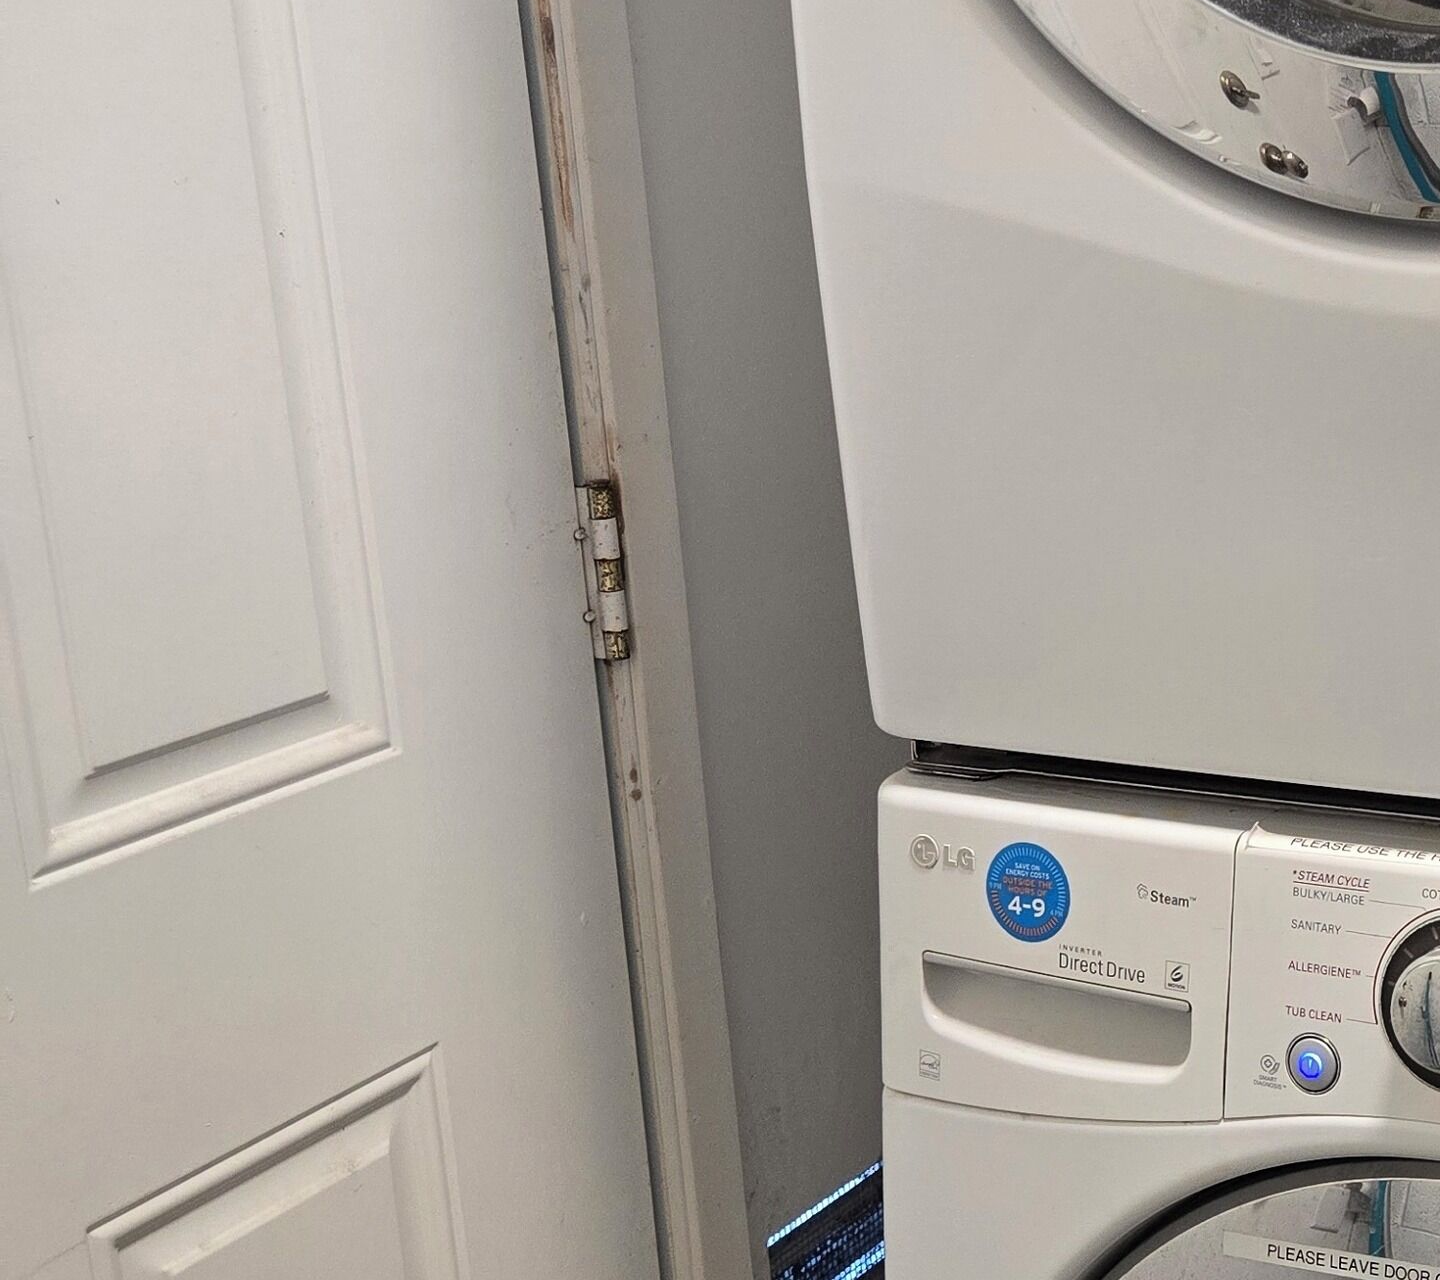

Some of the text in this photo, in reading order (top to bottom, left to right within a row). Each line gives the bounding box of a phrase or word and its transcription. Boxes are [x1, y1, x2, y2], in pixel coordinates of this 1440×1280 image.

[942, 843, 976, 871] LG
[1290, 838, 1352, 852] PLEASE
[1356, 845, 1390, 857] USE
[1395, 849, 1428, 860] THE
[1006, 868, 1050, 880] ENERGY COSTS
[1014, 862, 1030, 871] SAVE
[1002, 876, 1037, 888] OUTSIDE
[1337, 875, 1371, 889] CYCLE
[1293, 887, 1365, 906] BULKY/LARGE
[1007, 895, 1046, 918] 4-9
[1291, 919, 1342, 935] SANITARY
[1059, 944, 1102, 957] INVERTER
[1059, 952, 1146, 984] Direct Drive
[1285, 1005, 1342, 1023] TUB CLEAN
[1267, 1244, 1326, 1267] PLEASE
[1330, 1254, 1380, 1276] LEAVE
